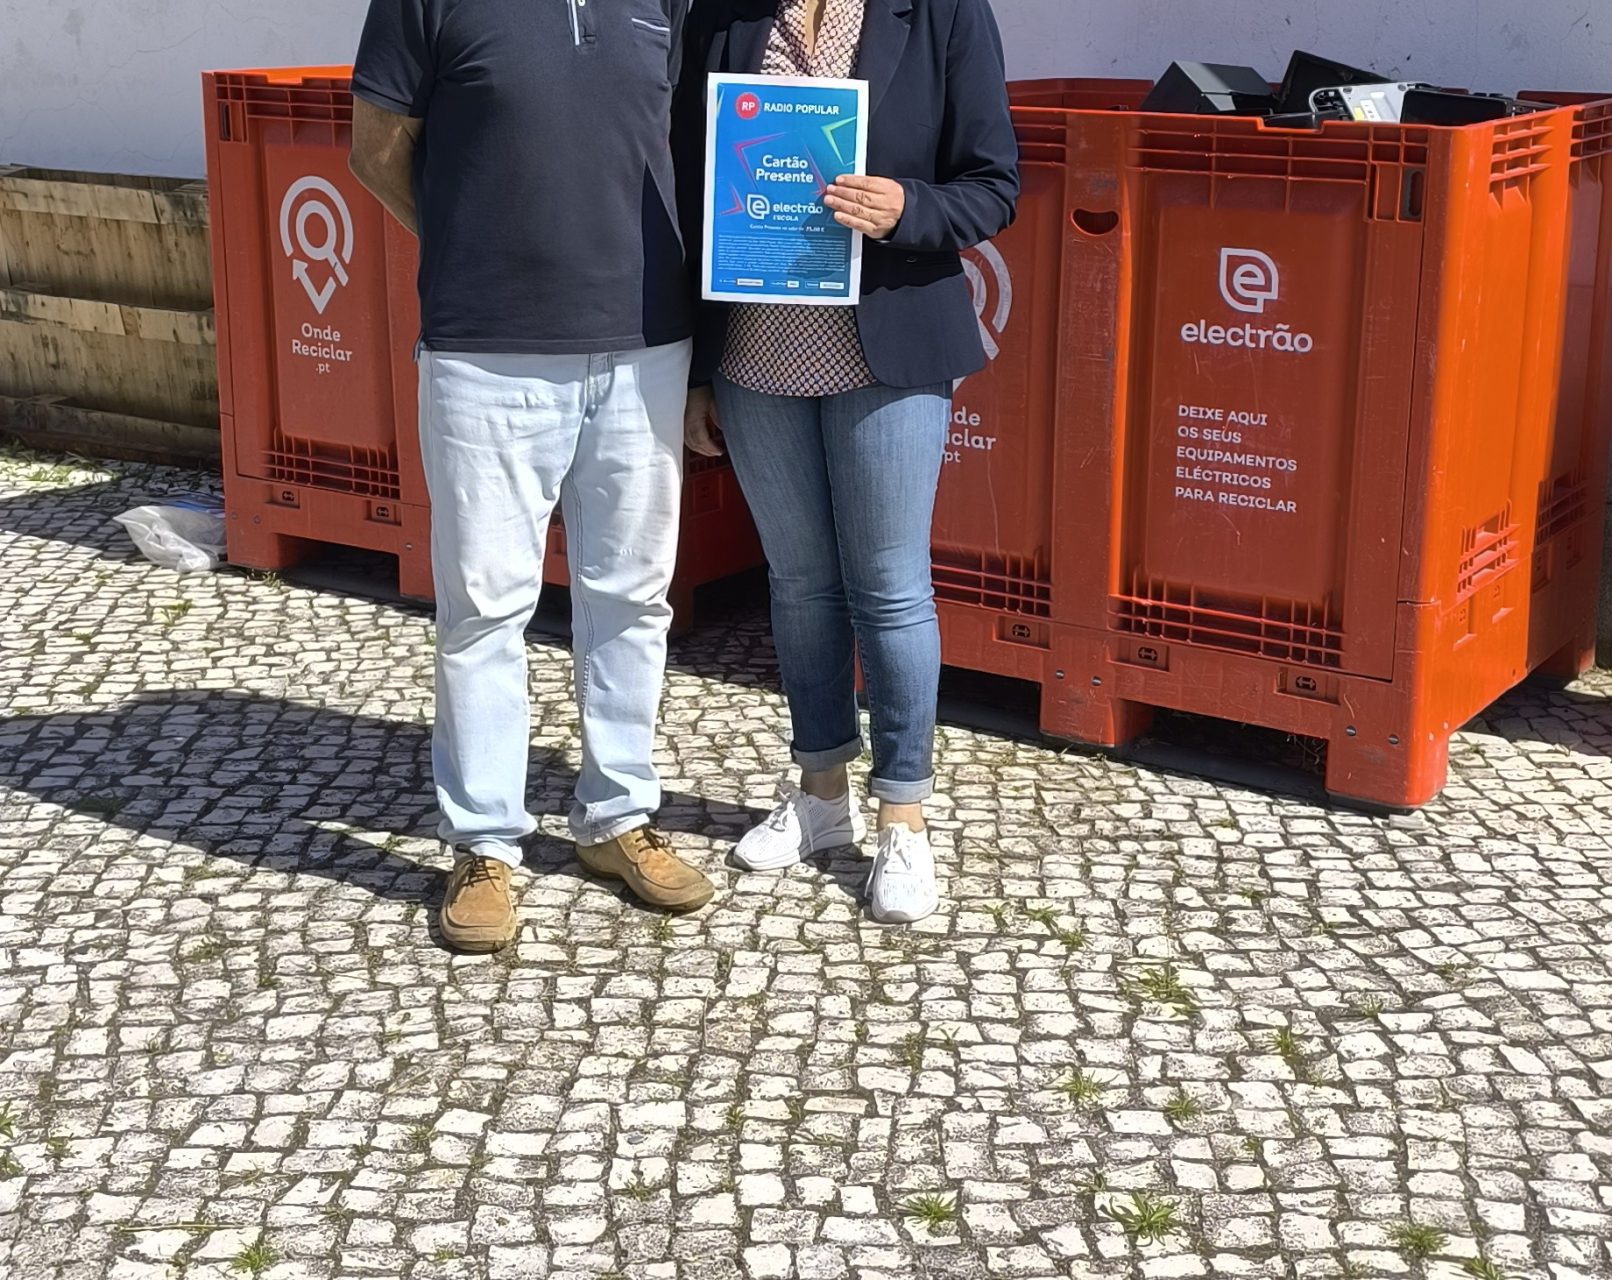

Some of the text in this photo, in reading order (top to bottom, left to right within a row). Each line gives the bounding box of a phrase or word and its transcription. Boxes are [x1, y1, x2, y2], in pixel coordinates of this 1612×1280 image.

[741, 101, 755, 111] RP
[764, 102, 840, 115] RADIO POPULAR
[762, 154, 809, 170] Cartão
[756, 169, 814, 183] Presente
[772, 201, 824, 214] electrão
[301, 322, 341, 342] Onde
[1180, 319, 1313, 353] electrão
[292, 339, 353, 362] Reciclar
[315, 362, 331, 375] .pt
[949, 406, 981, 426] de
[1178, 404, 1268, 426] DEIXE AQUI
[945, 428, 997, 450] iclar
[1177, 427, 1242, 444] OS SEUS
[944, 450, 961, 464] pt
[1176, 446, 1298, 471] EQUIPAMENTOS
[1176, 465, 1272, 489] ELÉCTRICOS
[1175, 486, 1297, 513] PARA RECICLAR
